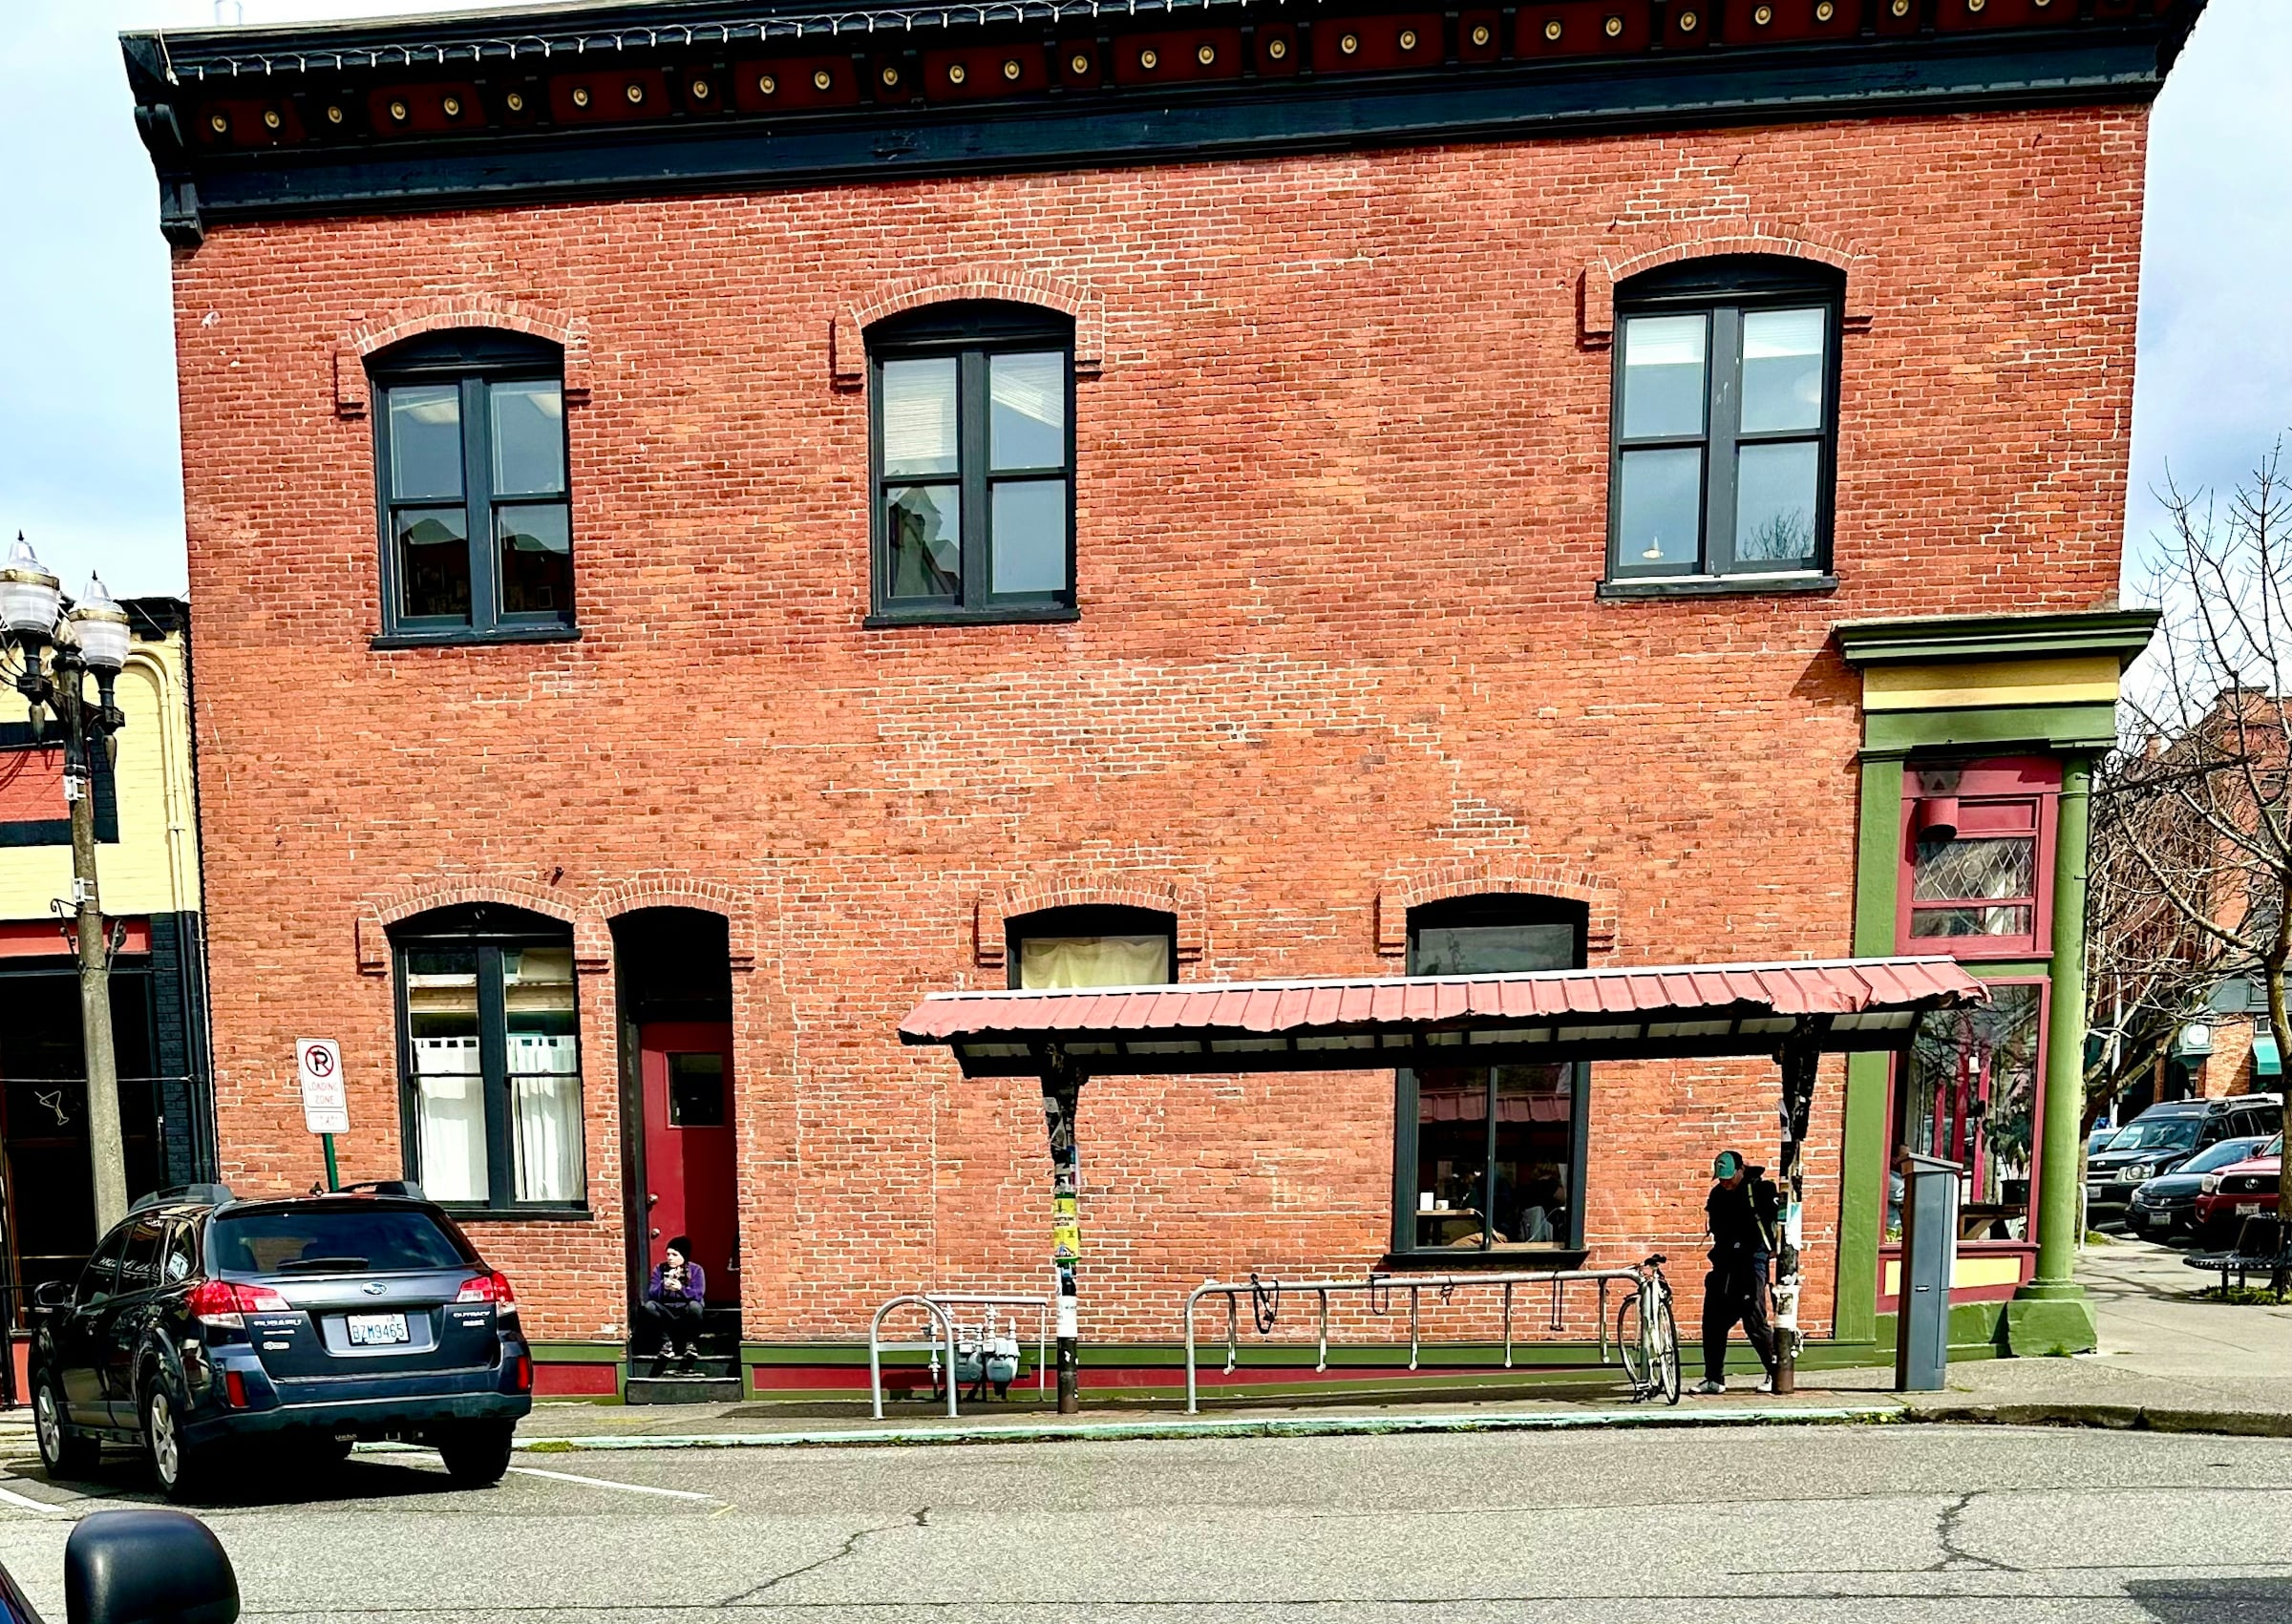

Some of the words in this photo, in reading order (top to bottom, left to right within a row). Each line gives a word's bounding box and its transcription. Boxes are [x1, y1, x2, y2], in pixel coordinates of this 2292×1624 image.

[308, 1081, 339, 1092] LOADING
[315, 1094, 335, 1106] ZONE
[351, 1323, 405, 1340] BZM9465
